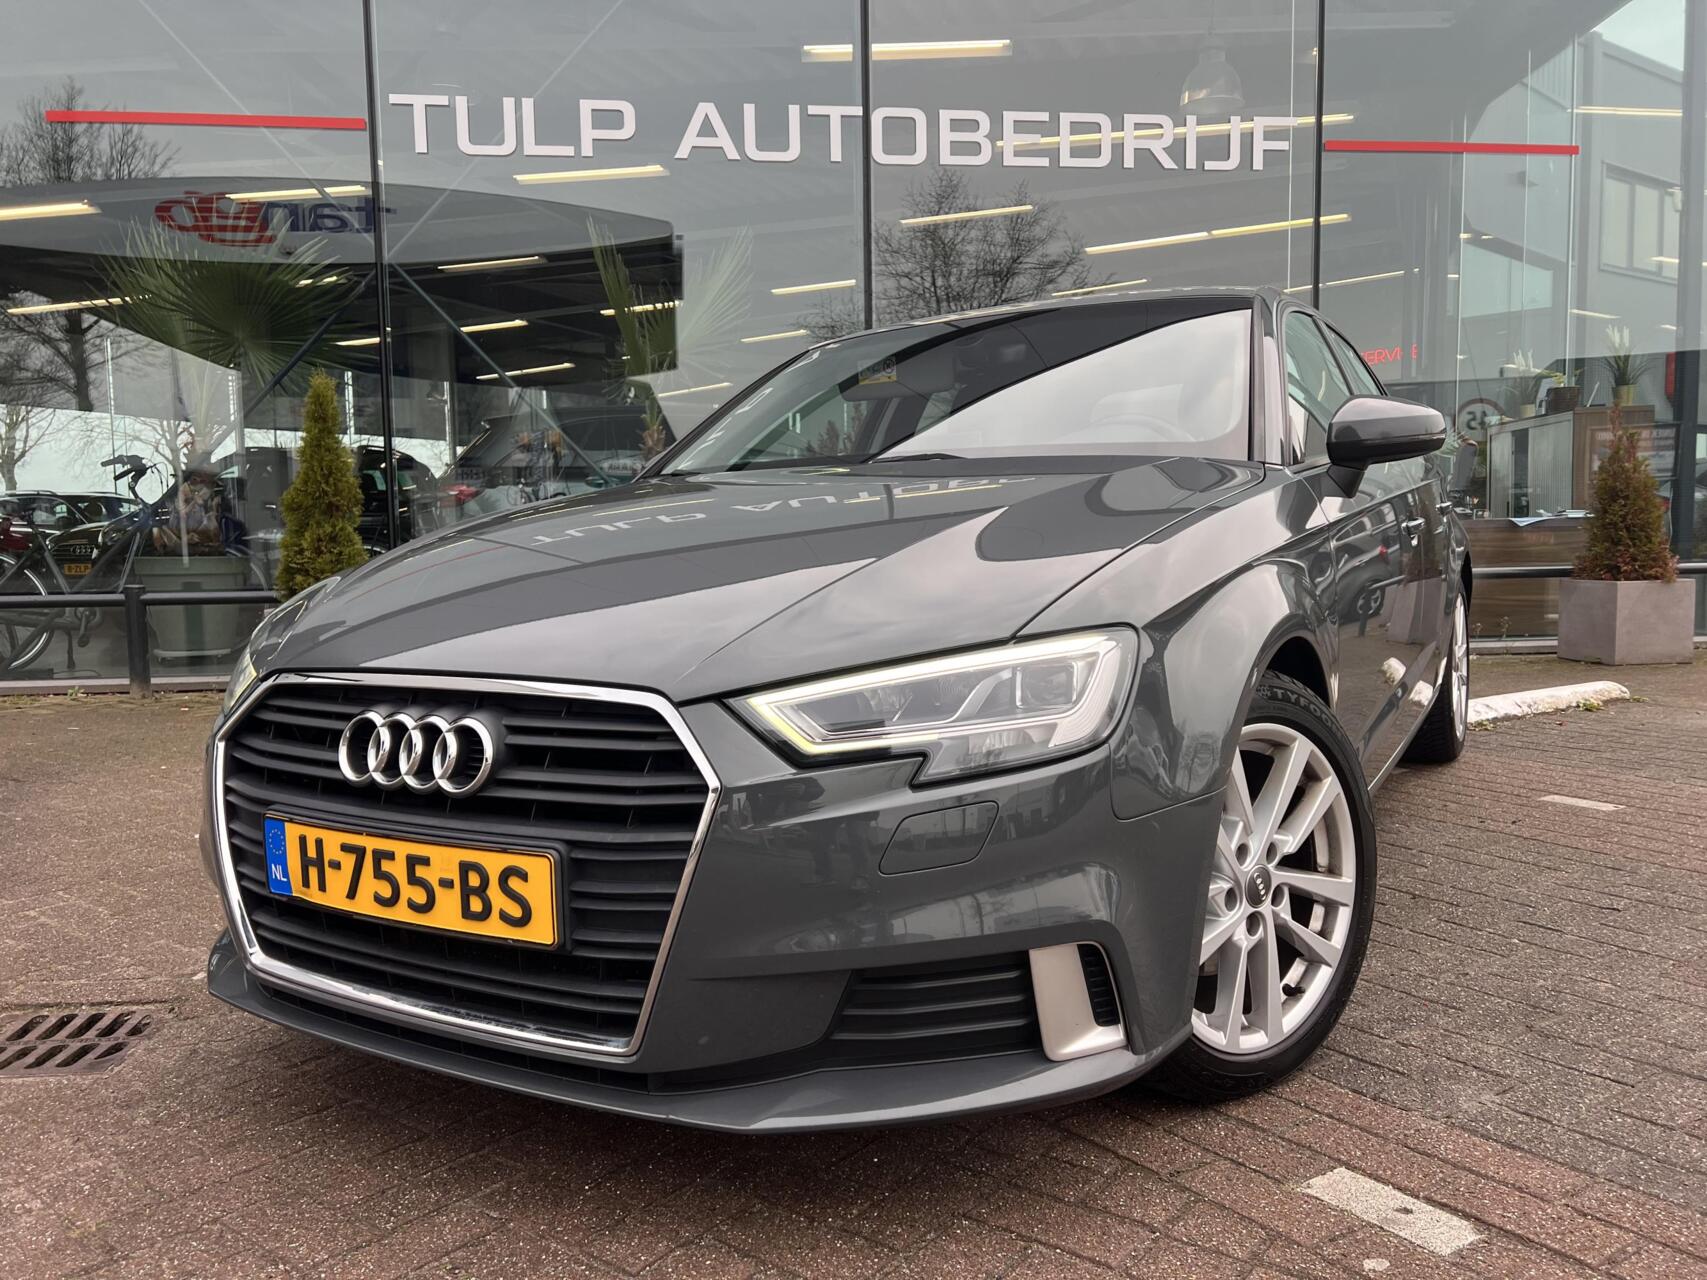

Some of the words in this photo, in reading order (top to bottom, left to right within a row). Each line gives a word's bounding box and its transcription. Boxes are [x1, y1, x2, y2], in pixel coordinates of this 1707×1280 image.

[388, 93, 636, 158] TULP
[674, 101, 1299, 171] AUTOBEDRIJF
[271, 863, 287, 882] NL
[298, 833, 533, 928] H-755-BS
